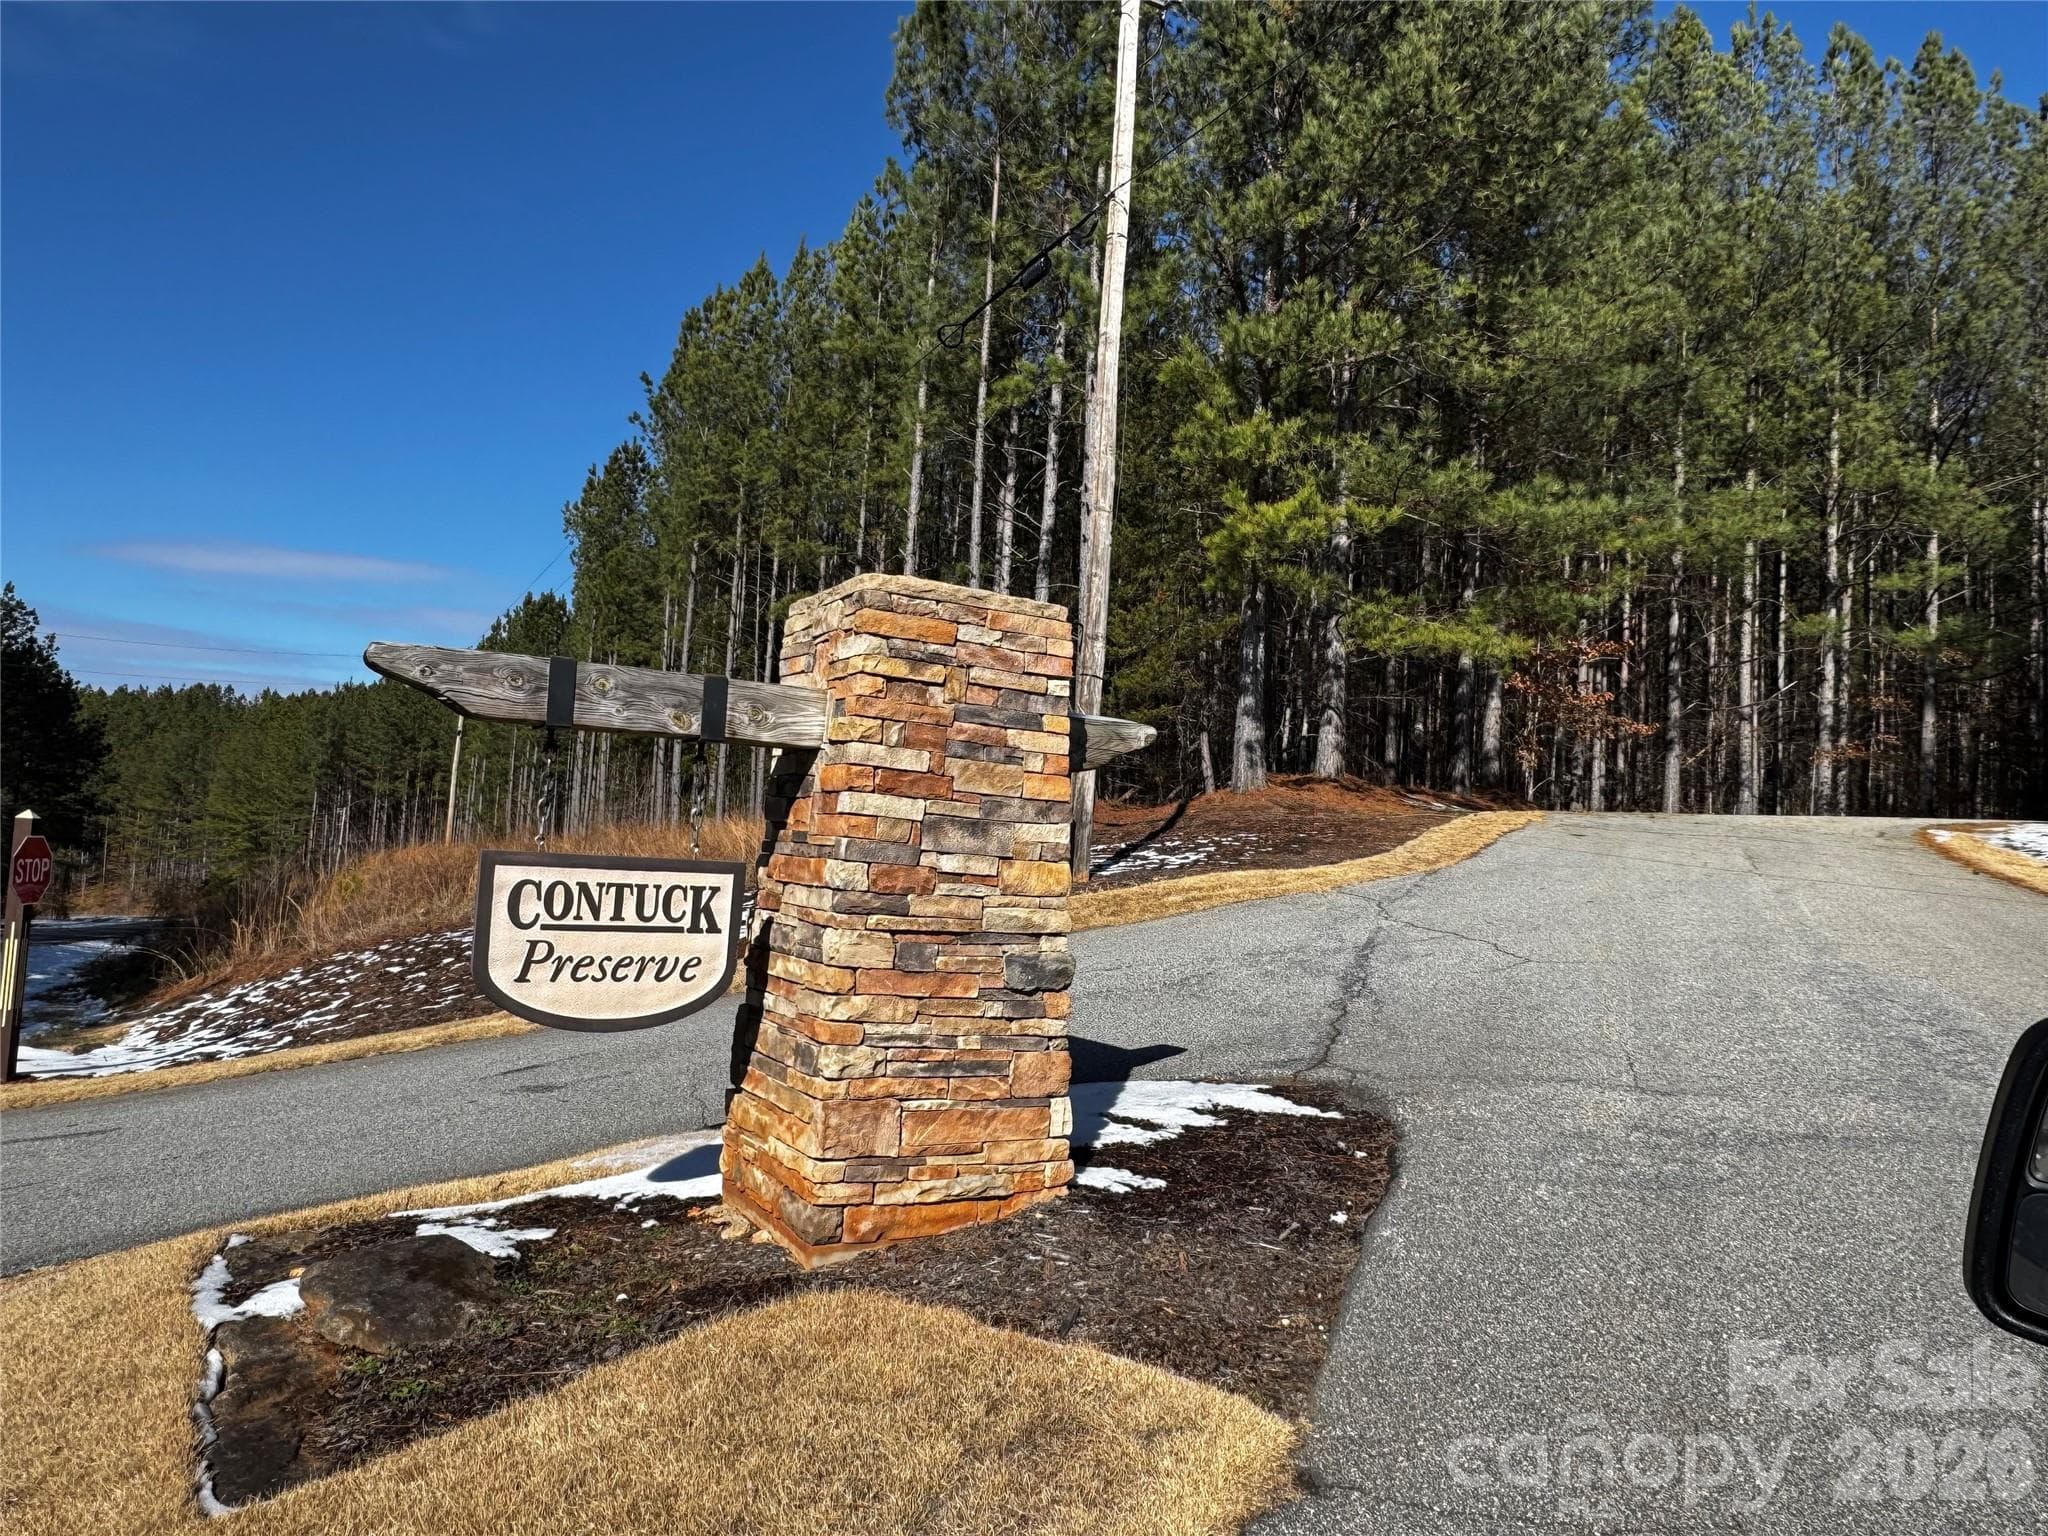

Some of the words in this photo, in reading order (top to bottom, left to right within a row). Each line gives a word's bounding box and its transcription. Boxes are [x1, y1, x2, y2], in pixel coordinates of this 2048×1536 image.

[15, 858, 50, 883] STOP
[507, 879, 722, 934] CONTUCK
[514, 939, 702, 983] Preserve
